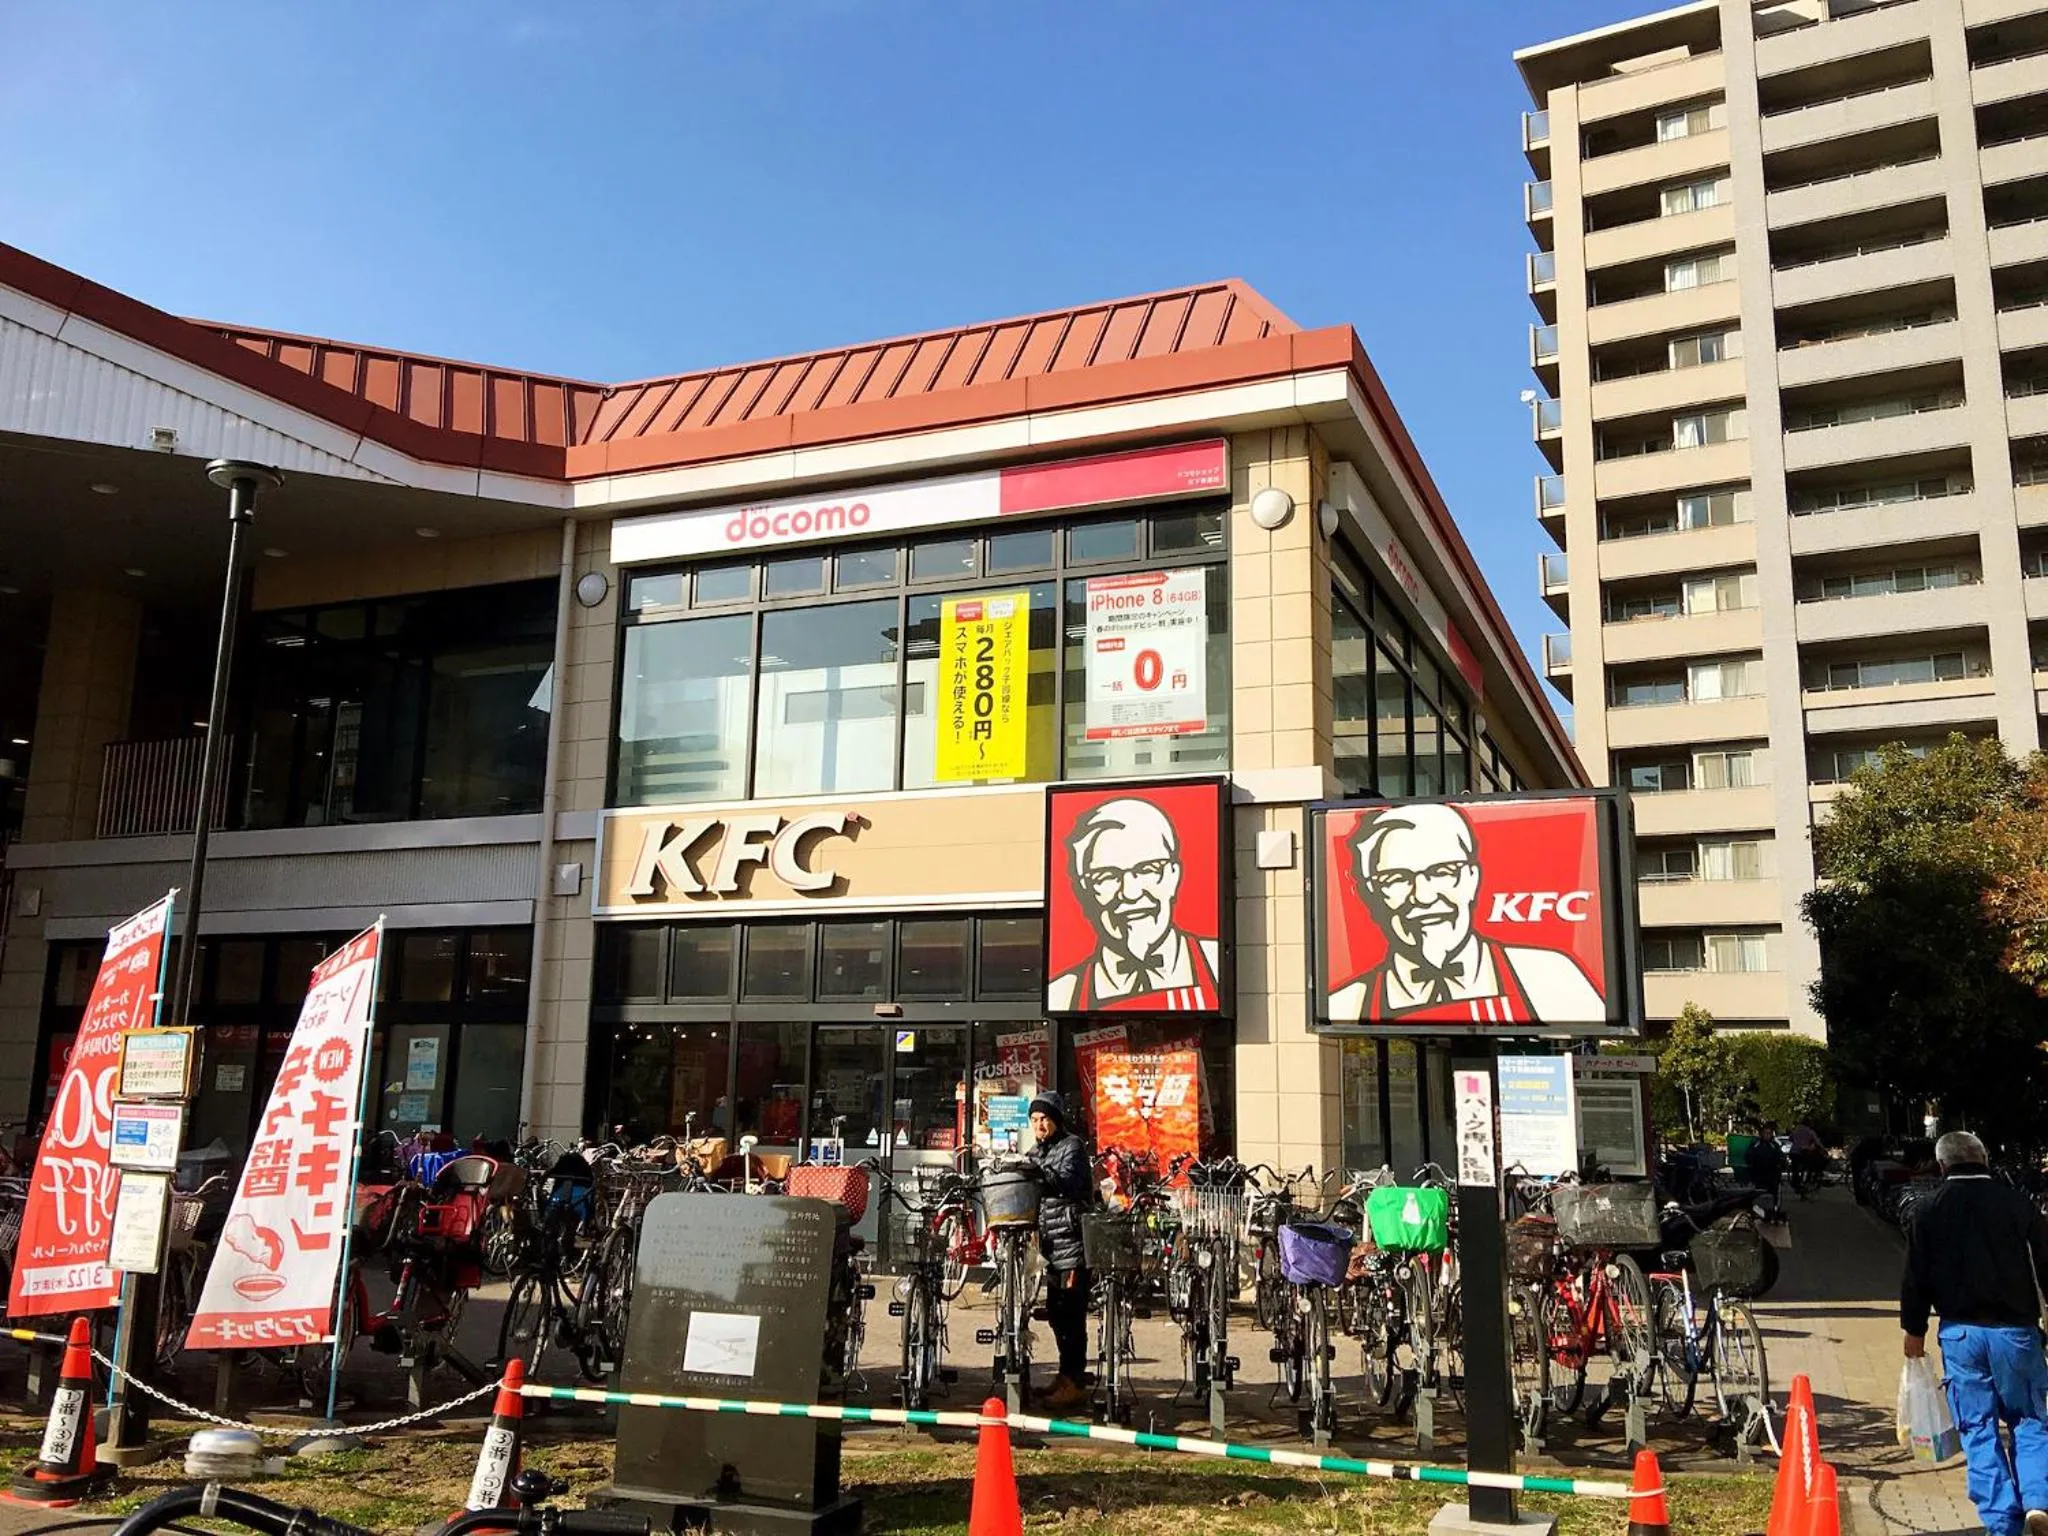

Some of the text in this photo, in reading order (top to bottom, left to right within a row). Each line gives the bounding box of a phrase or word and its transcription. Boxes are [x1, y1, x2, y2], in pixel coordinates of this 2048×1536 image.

[725, 502, 871, 543] docomo
[1090, 593, 1145, 612] iPhone
[1152, 588, 1163, 605] 8
[1134, 648, 1164, 691] 0
[1172, 674, 1187, 689] 円
[622, 811, 848, 896] KFC
[1486, 891, 1591, 923] KFC
